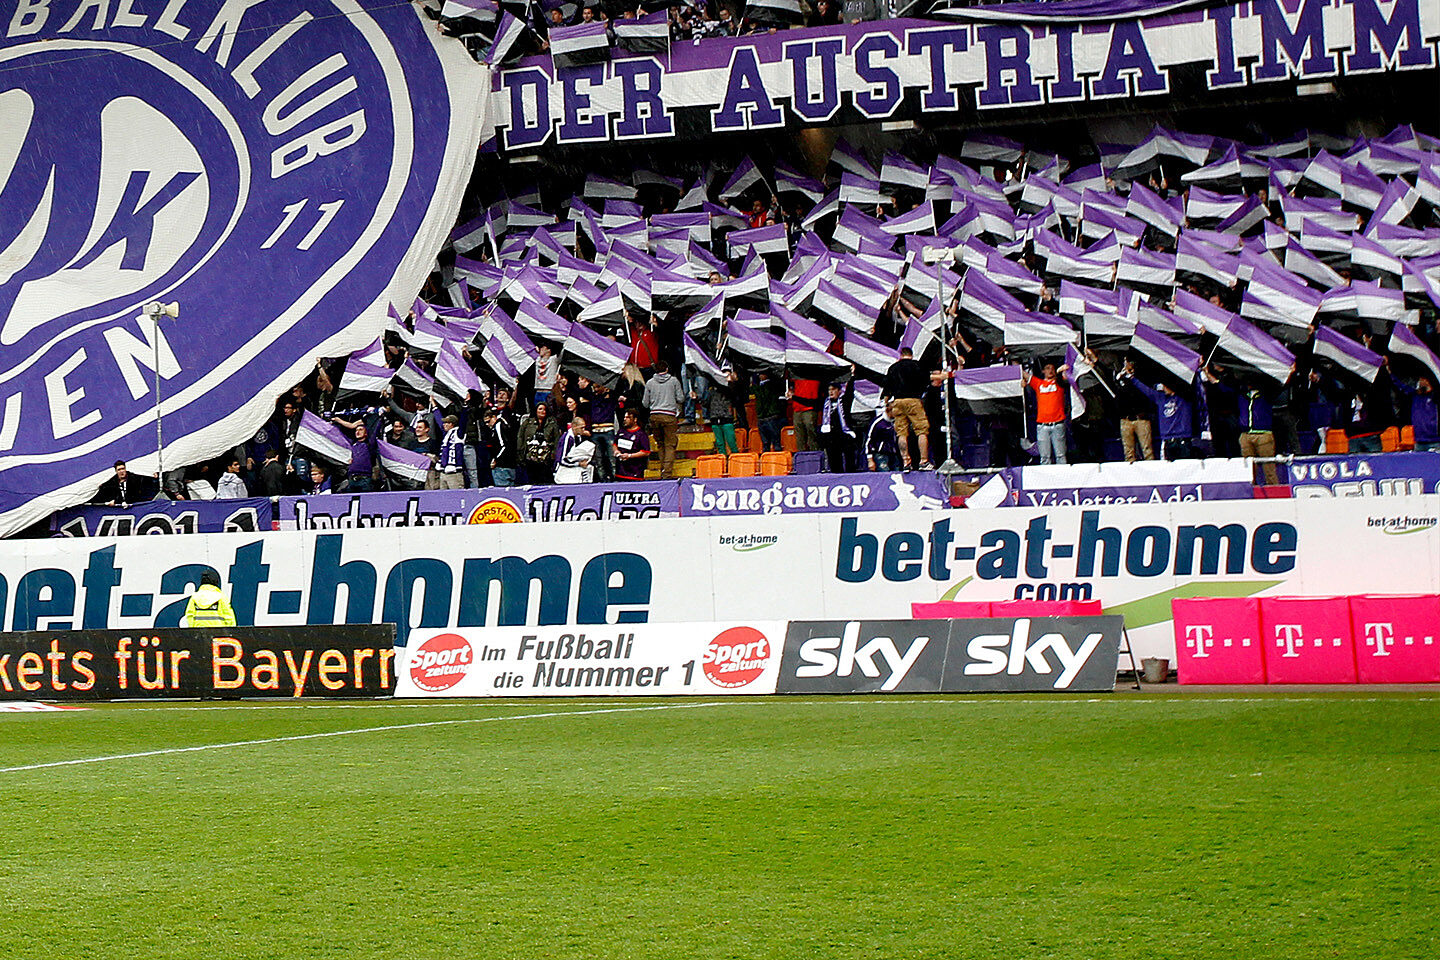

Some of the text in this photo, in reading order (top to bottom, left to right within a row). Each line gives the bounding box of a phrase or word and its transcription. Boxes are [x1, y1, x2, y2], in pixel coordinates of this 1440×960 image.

[501, 56, 675, 151] DER
[711, 18, 1169, 132] AUSTRIA
[260, 197, 345, 253] 11
[1291, 460, 1373, 481] VIOLA
[614, 491, 660, 505] ULTRA
[691, 481, 871, 516] Lungauer
[1367, 515, 1438, 528] bet-at-home
[719, 534, 778, 545] bet-at-home
[834, 509, 1298, 583] bet-at-home
[116, 637, 191, 690] für
[410, 644, 471, 671] Sport
[703, 637, 768, 666] Sport
[796, 621, 931, 690] sky
[964, 618, 1103, 690] sky
[493, 671, 524, 689] die
[532, 660, 670, 689] Nummer
[681, 660, 696, 687] 1
